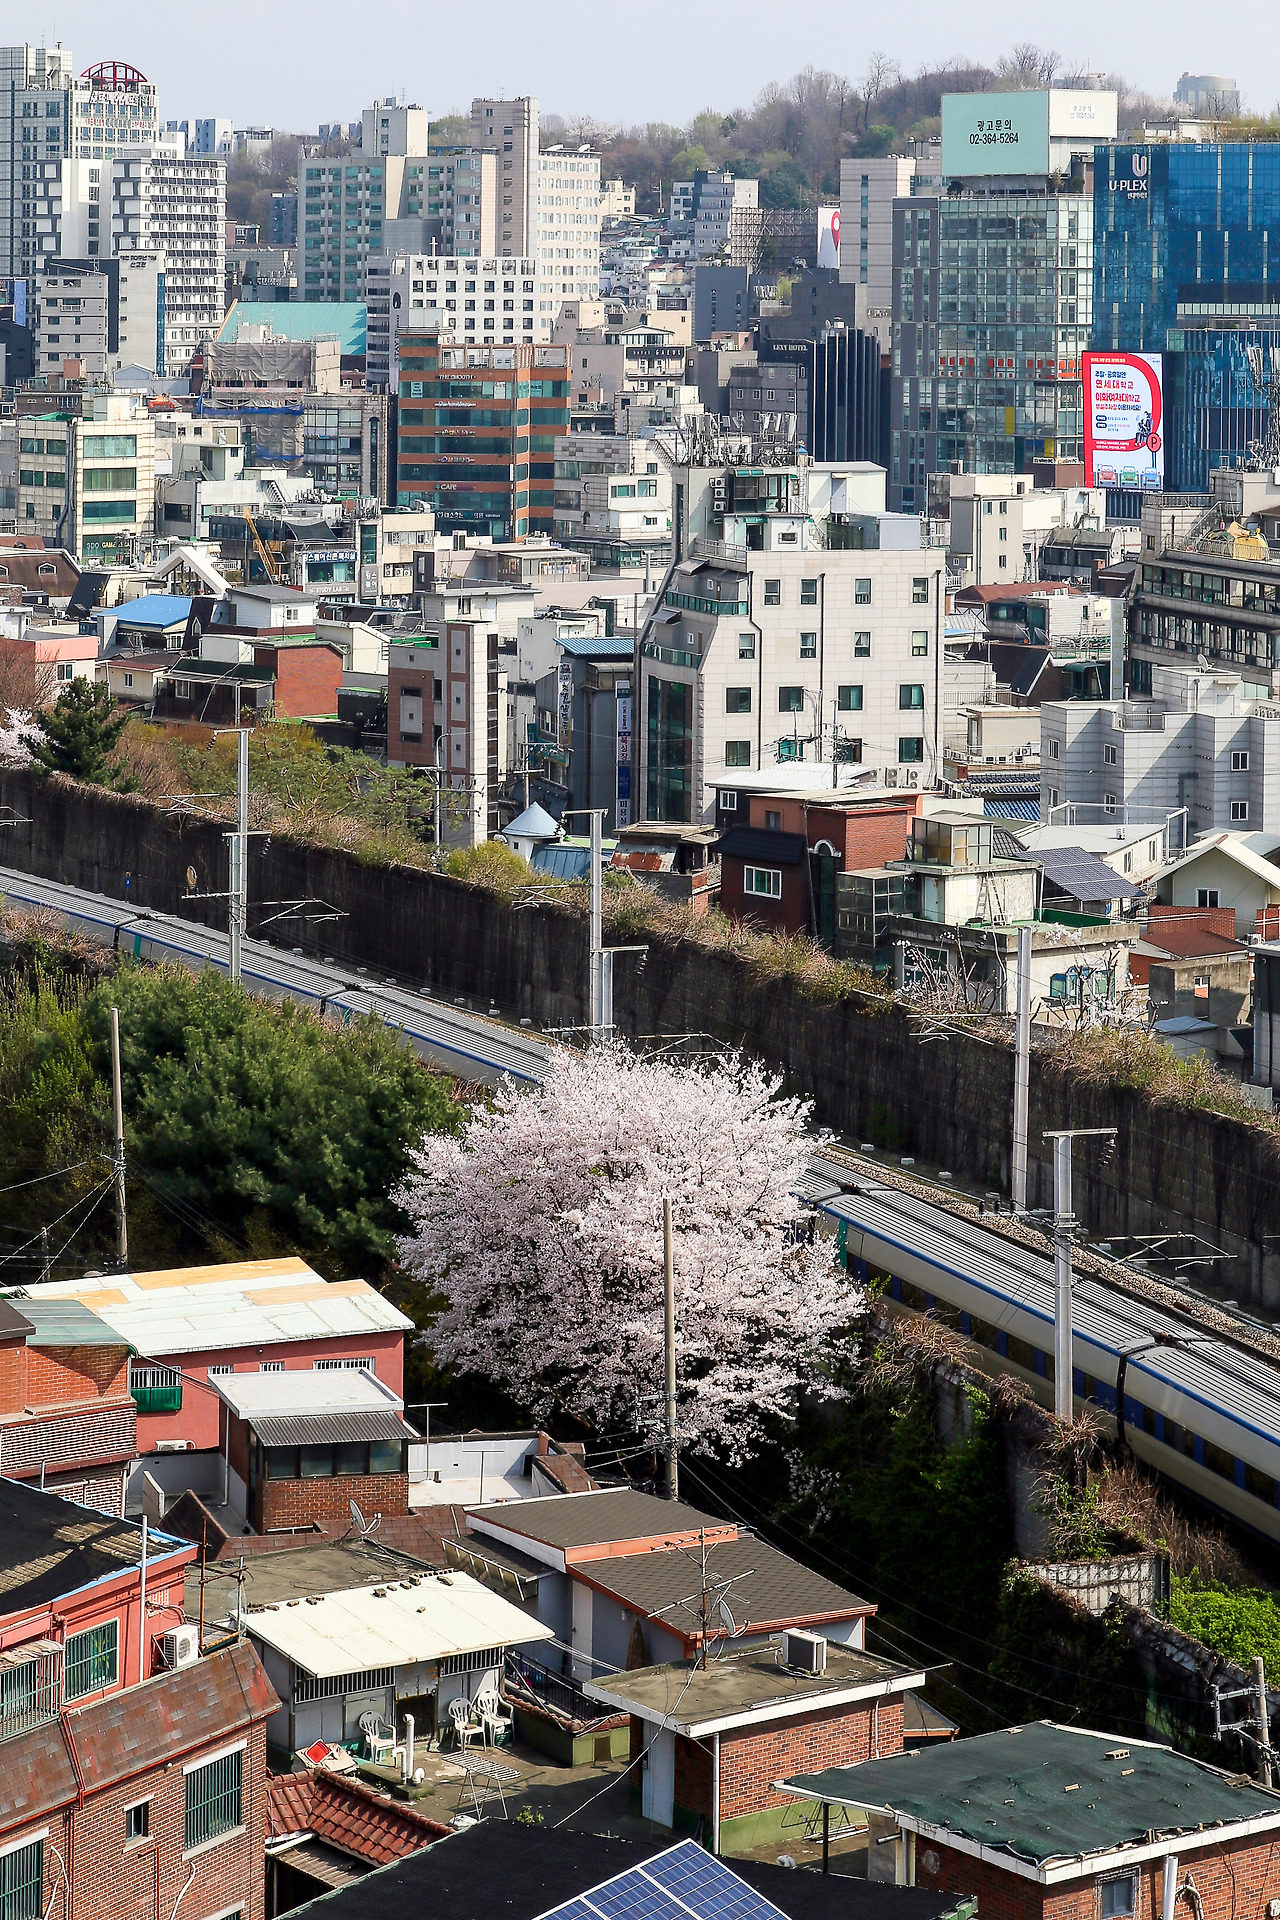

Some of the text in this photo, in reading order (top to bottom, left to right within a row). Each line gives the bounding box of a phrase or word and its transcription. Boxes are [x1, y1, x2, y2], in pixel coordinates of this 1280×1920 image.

[977, 119, 1012, 132] 광고문의
[969, 133, 1019, 144] 02-364-5264
[1109, 180, 1147, 191] U-PLEX
[1096, 379, 1134, 389] 연세대학교
[1095, 392, 1141, 403] 이화여자대학교
[619, 800, 628, 825] 미용실
